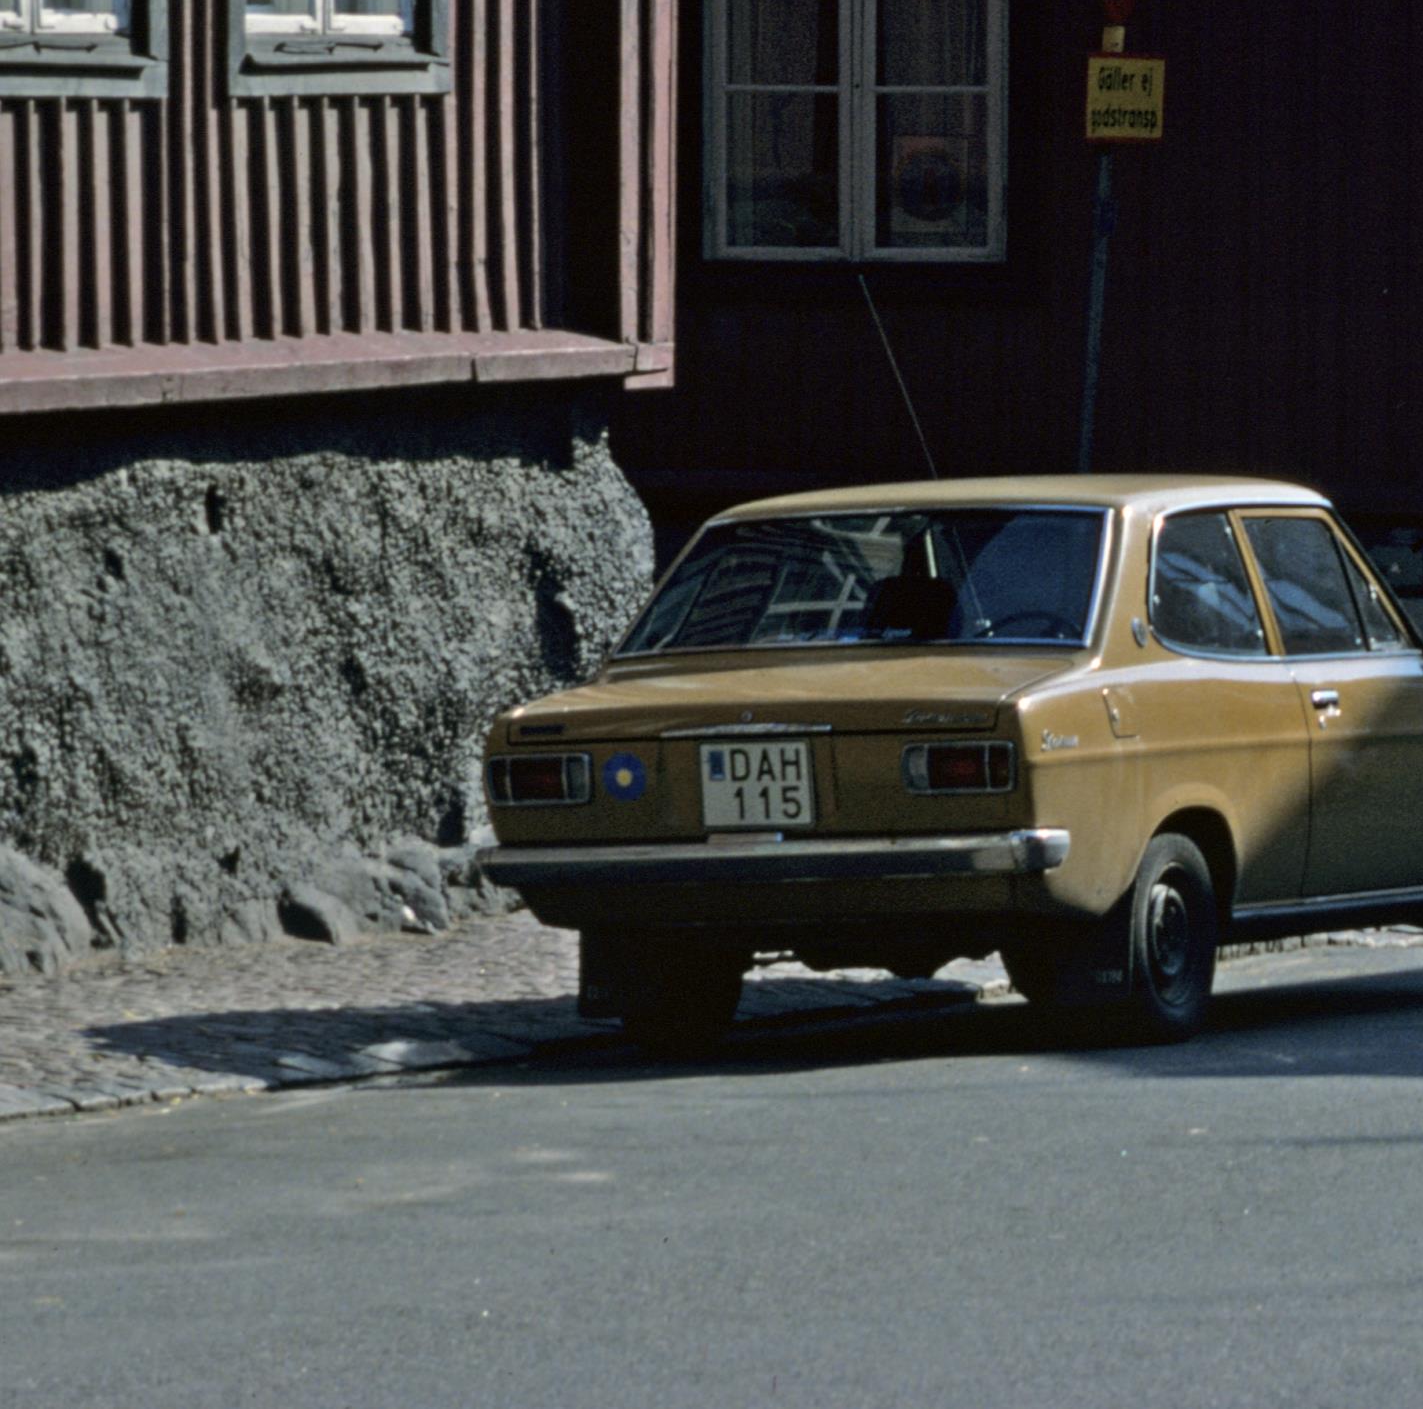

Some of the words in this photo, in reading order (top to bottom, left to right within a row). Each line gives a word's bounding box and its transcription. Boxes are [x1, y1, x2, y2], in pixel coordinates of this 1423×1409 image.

[1141, 67, 1153, 97] ej
[729, 747, 801, 782] DAH
[734, 785, 802, 820] 115
